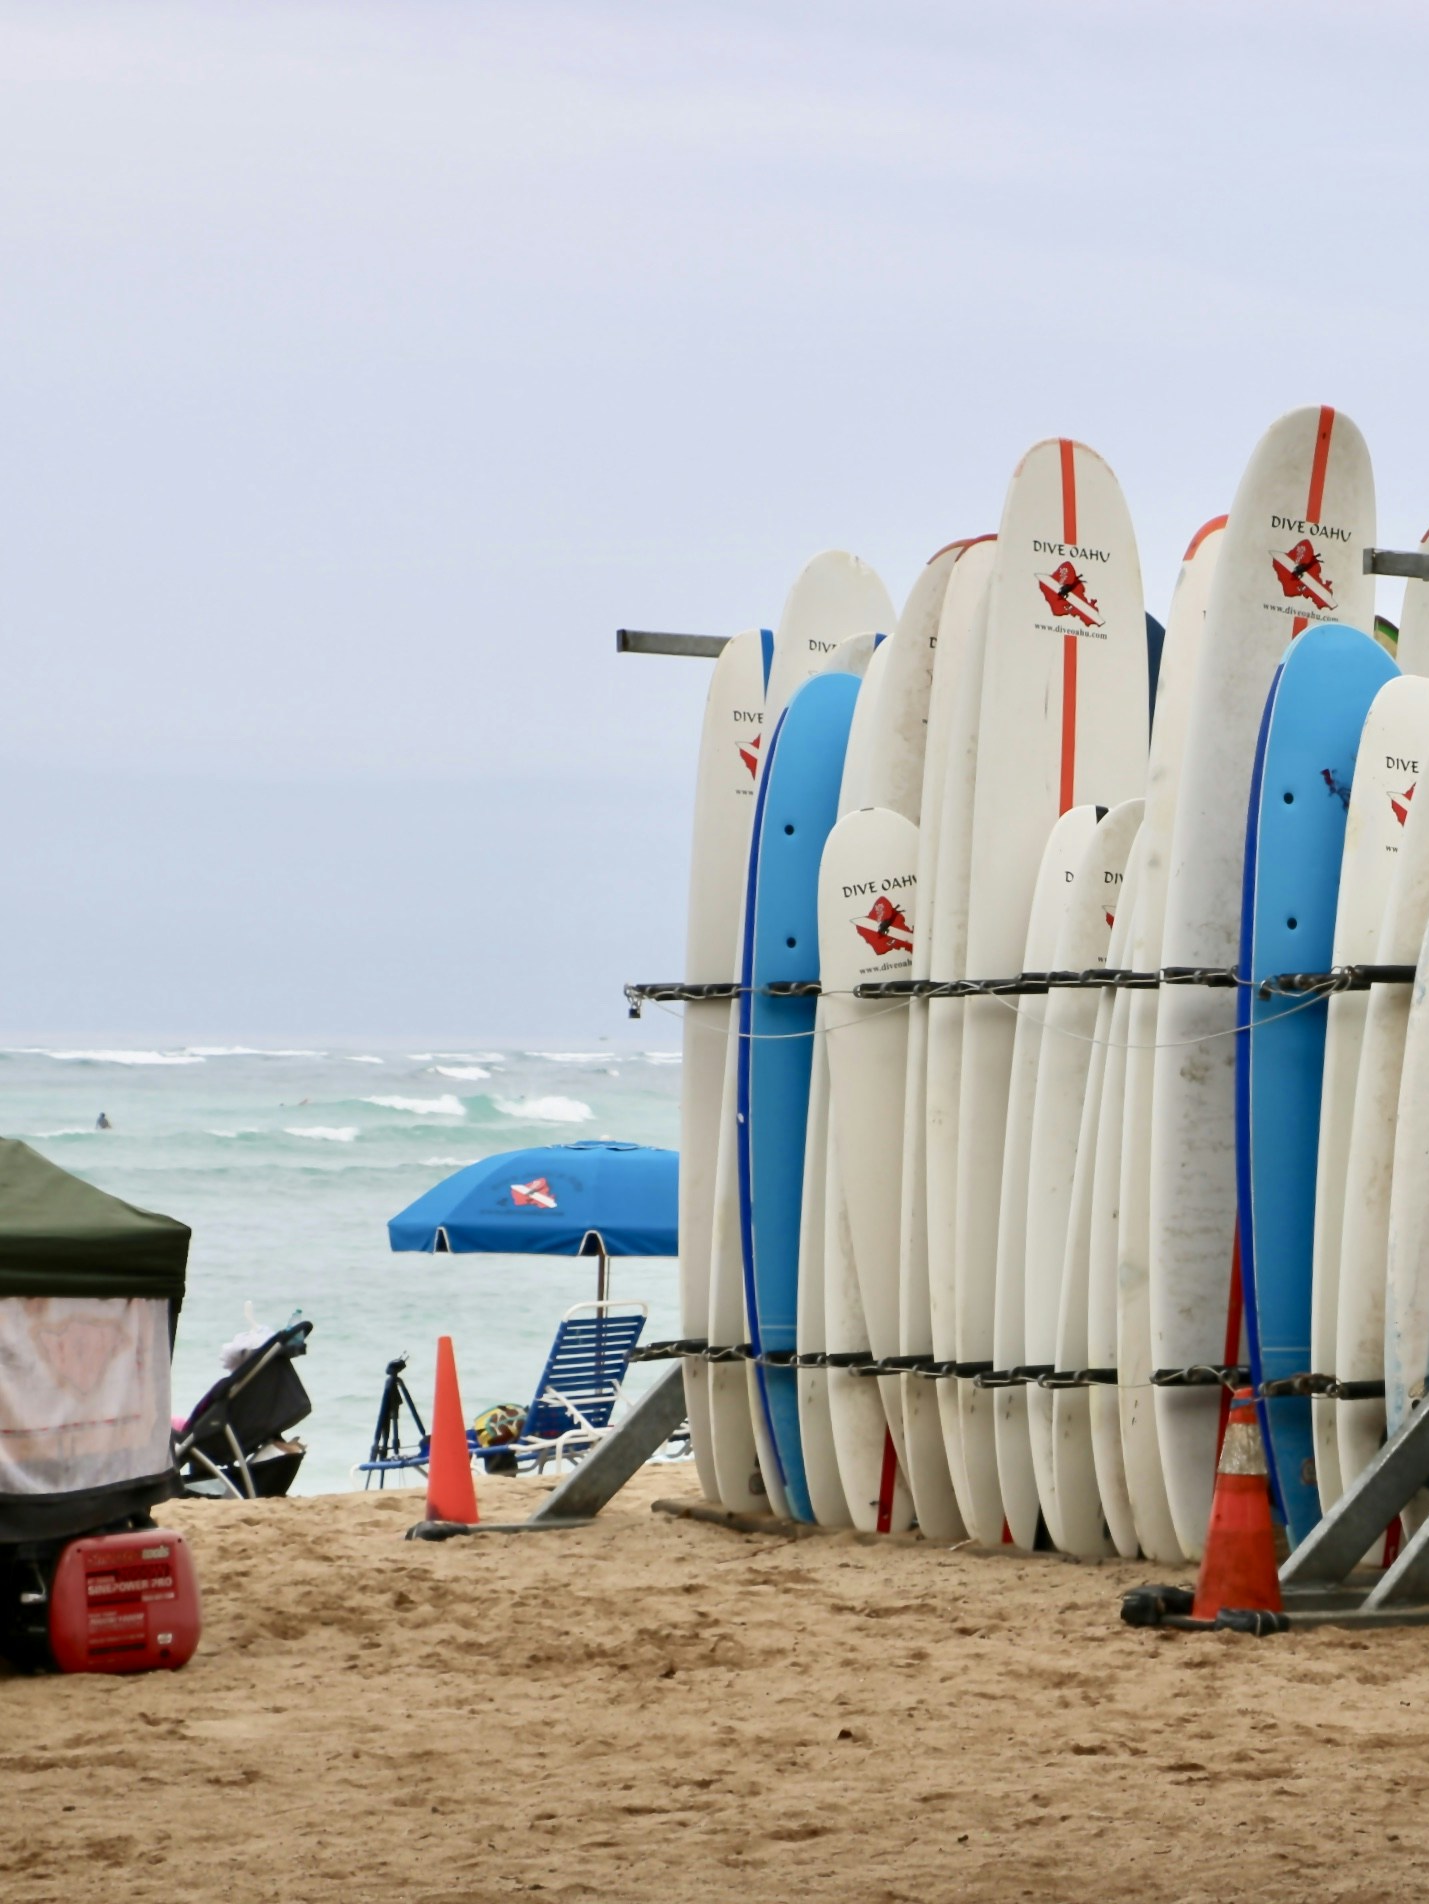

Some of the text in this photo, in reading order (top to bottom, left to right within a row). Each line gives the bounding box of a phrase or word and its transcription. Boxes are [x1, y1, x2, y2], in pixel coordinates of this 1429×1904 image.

[1271, 515, 1352, 543] DIVE OAHU
[1033, 539, 1110, 563] DIVE OAHU
[1262, 603, 1339, 623] www.diveoahu.com
[1034, 623, 1108, 640] www.diveoahu.com
[808, 639, 837, 653] DIV
[733, 710, 764, 724] DIVE
[1385, 756, 1420, 774] DIVE
[842, 881, 878, 898] DIVE
